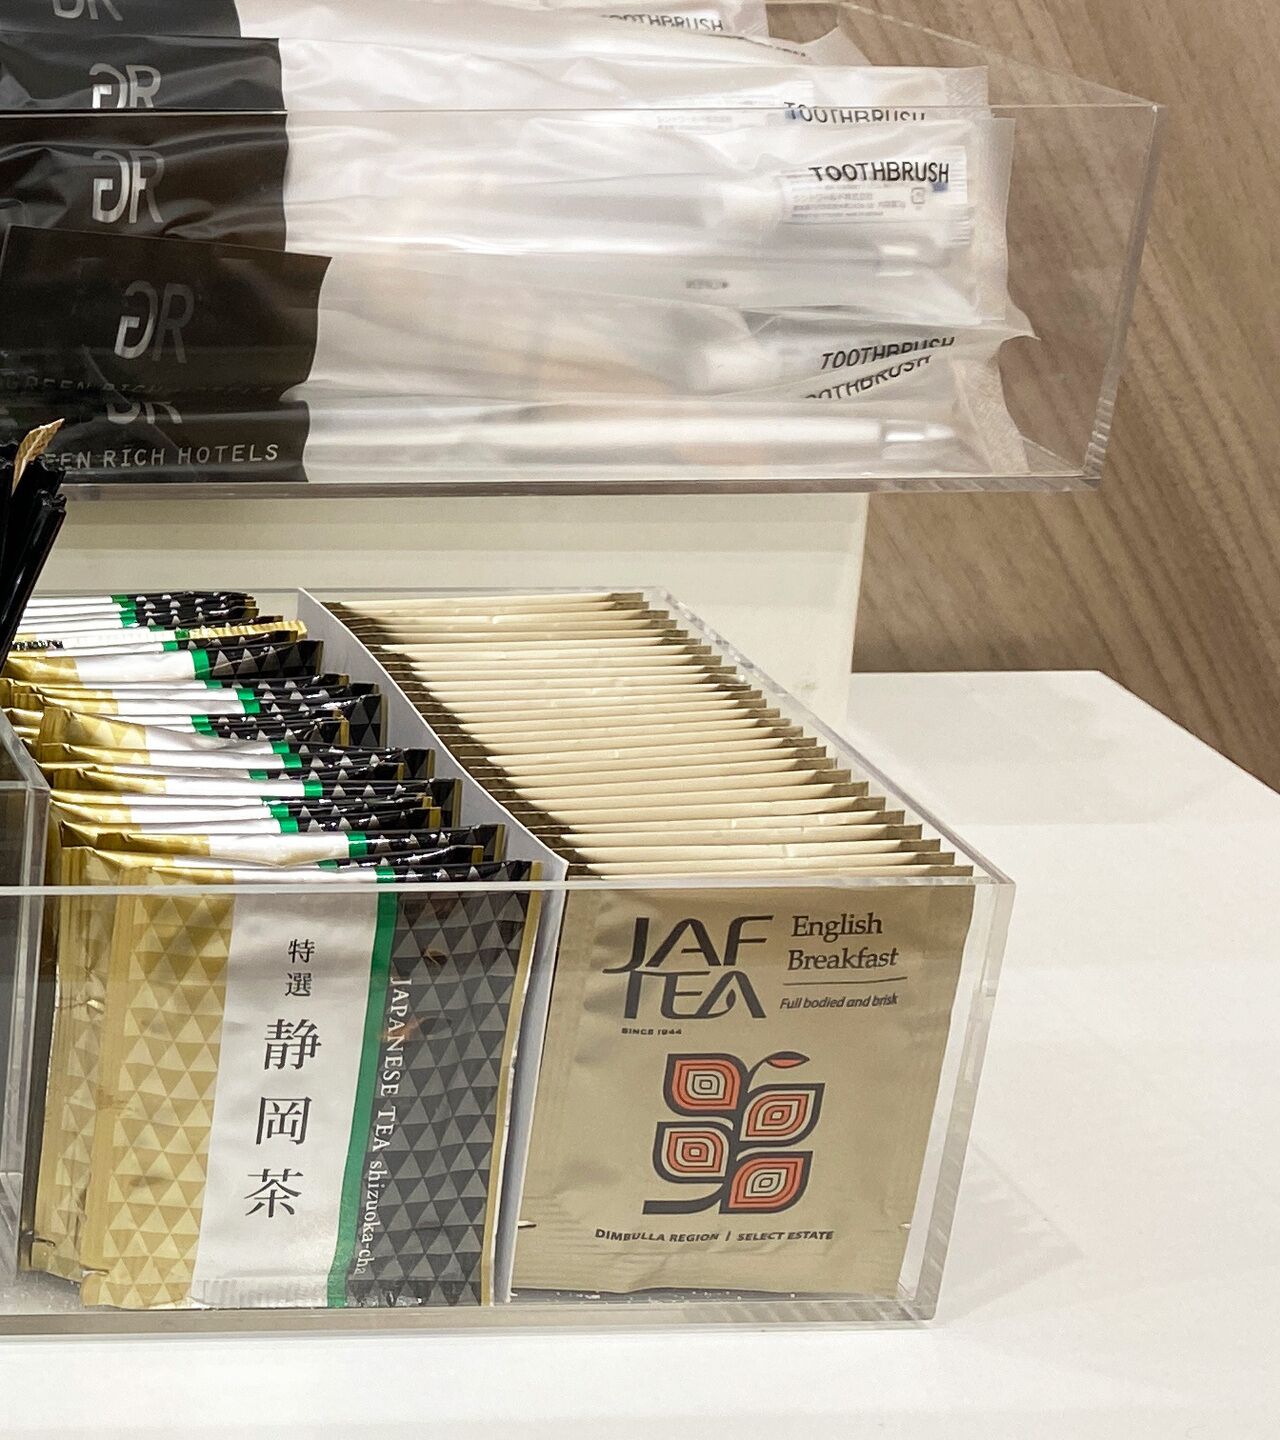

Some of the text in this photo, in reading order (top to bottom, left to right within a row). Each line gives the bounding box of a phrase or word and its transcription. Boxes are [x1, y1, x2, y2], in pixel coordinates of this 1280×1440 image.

[808, 161, 950, 184] TOOTHBRUSH
[102, 448, 166, 469] RICH
[177, 442, 281, 465] HOTELS
[790, 911, 883, 943] English
[602, 915, 775, 974] JAF
[787, 947, 900, 971] Breakfast
[283, 937, 317, 998] 特選
[623, 970, 768, 1020] TEA
[779, 993, 899, 1010] Full bodied and brisk
[621, 1027, 654, 1036] SINCE
[244, 1017, 323, 1219] 静岡茶
[355, 977, 412, 1275] JAPANESE TEA shizuoka-cha
[594, 1228, 835, 1243] DIMBULLA REGION SELECT ESTATE
